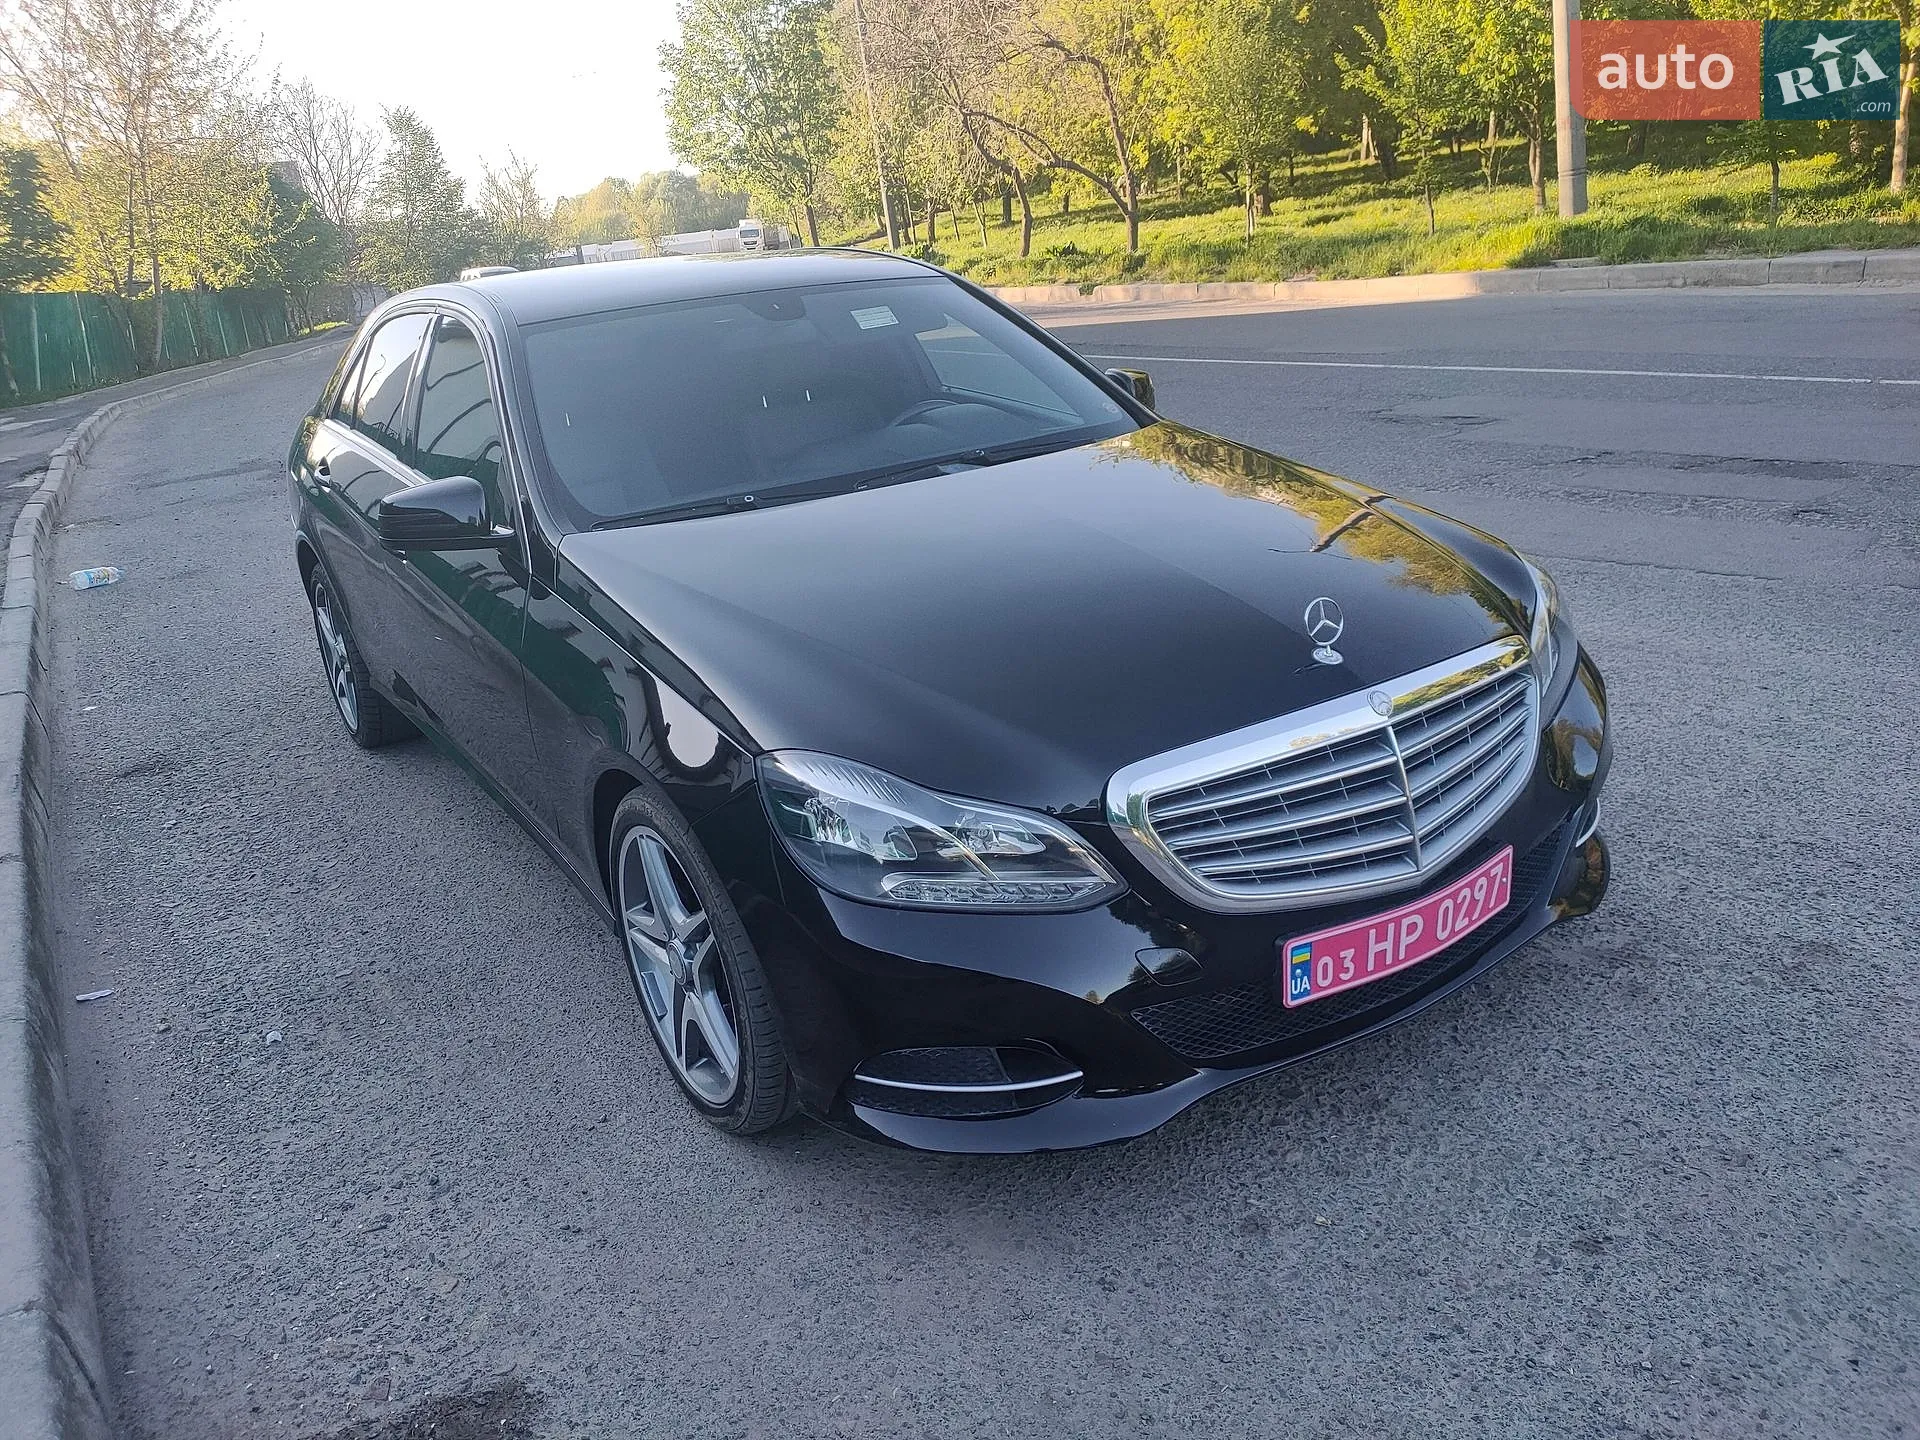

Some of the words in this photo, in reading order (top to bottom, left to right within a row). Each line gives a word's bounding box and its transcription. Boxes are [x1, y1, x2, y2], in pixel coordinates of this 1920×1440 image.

[1316, 948, 1355, 987] 03
[1367, 914, 1424, 972] HP
[1436, 862, 1504, 941] 0297
[1291, 976, 1311, 995] UA
